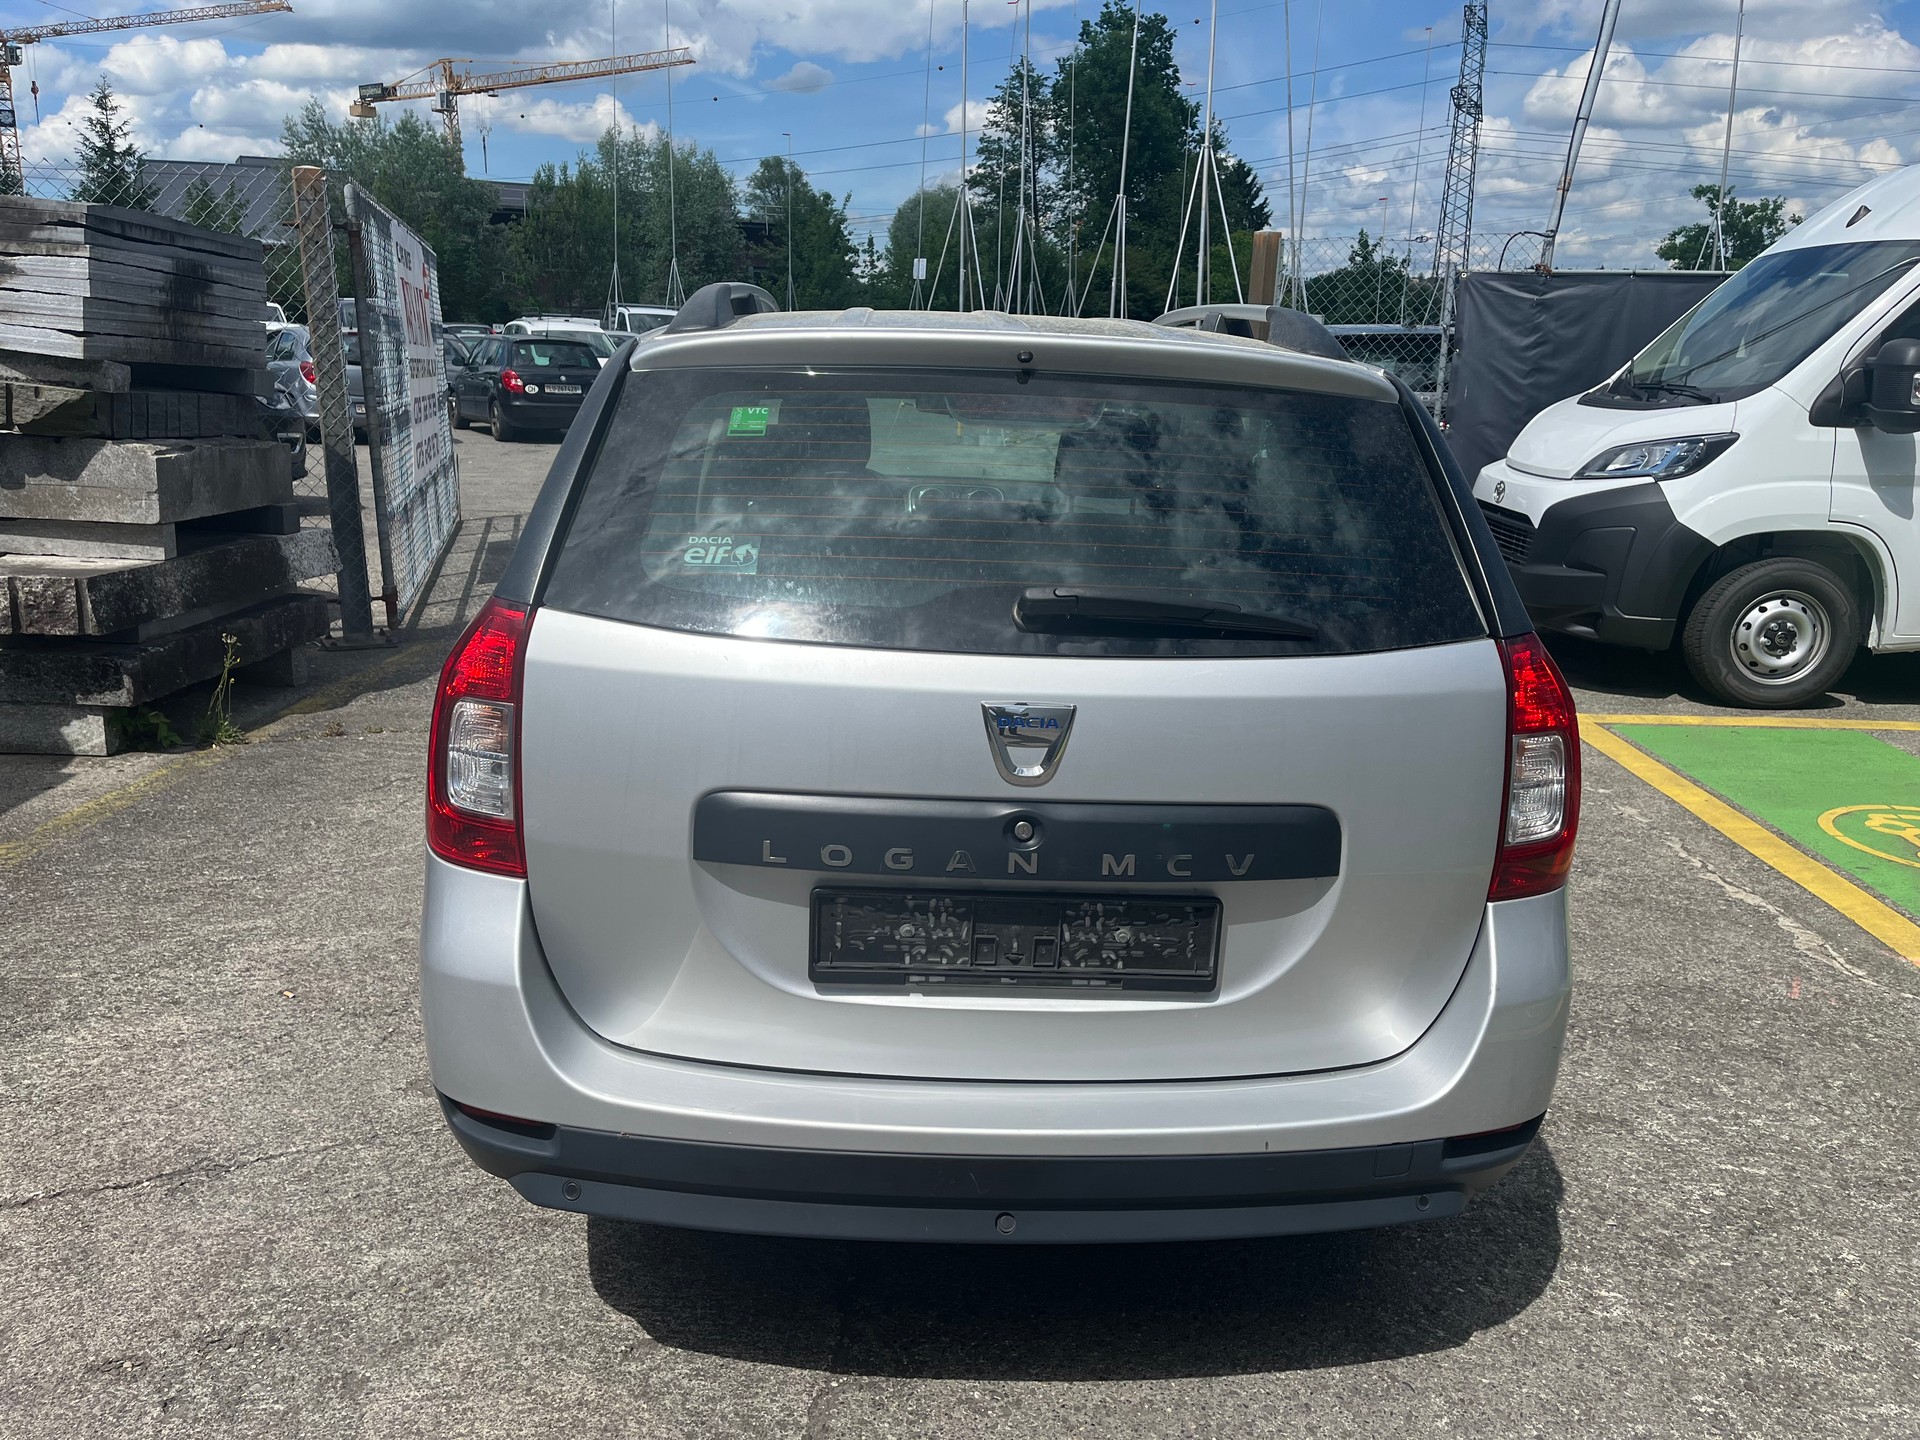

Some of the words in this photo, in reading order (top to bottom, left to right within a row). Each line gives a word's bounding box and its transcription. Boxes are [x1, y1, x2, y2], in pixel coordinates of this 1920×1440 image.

[748, 407, 769, 415] VTC
[688, 536, 733, 544] DACIA
[684, 545, 732, 564] elf
[997, 717, 1060, 729] DACIA
[762, 839, 1039, 875] LOGAN
[1101, 852, 1255, 877] MCV
